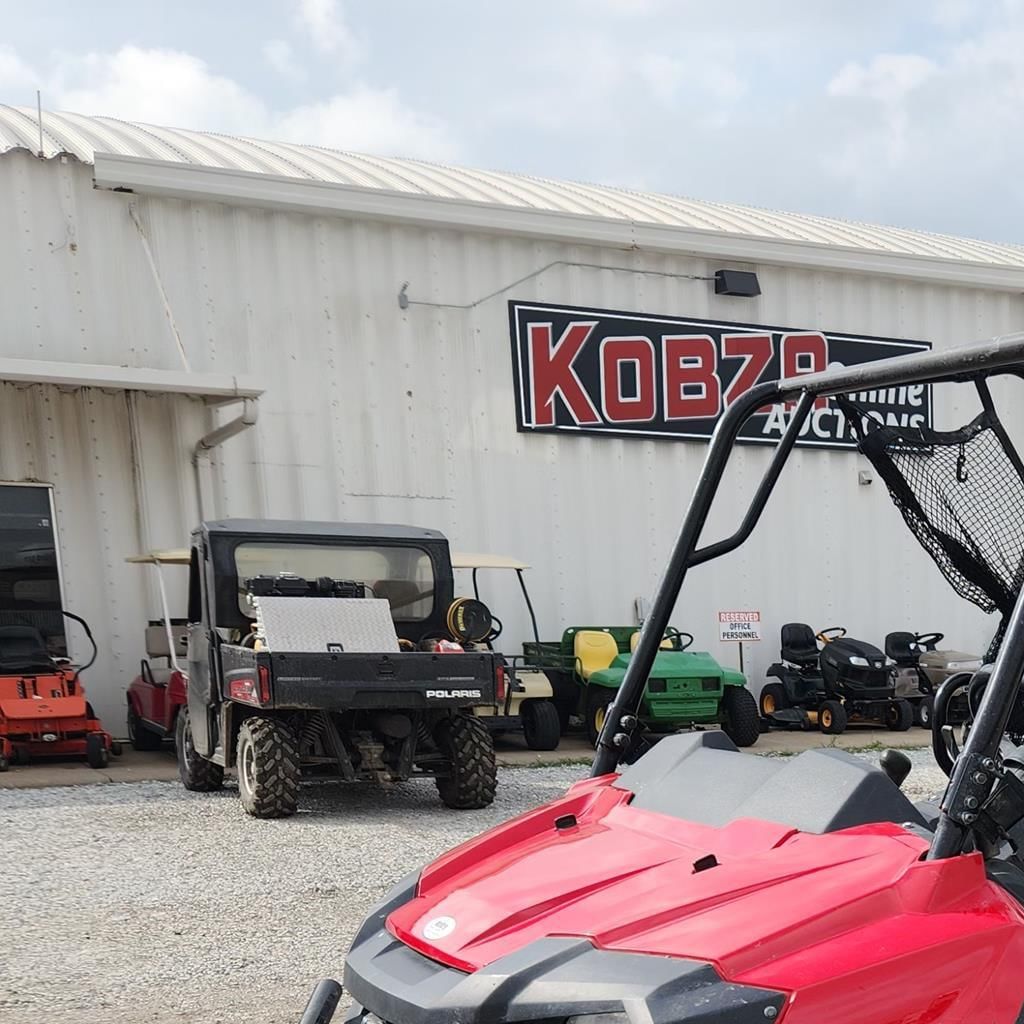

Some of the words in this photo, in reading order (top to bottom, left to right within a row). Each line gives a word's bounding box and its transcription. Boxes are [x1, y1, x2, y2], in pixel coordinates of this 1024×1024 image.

[527, 320, 828, 429] KOBZA
[762, 403, 925, 439] AUCTONS
[720, 612, 759, 622] RESERVED
[730, 622, 751, 630] OFFICE
[722, 631, 759, 639] PERSONNEL
[426, 690, 481, 698] POLARIS
